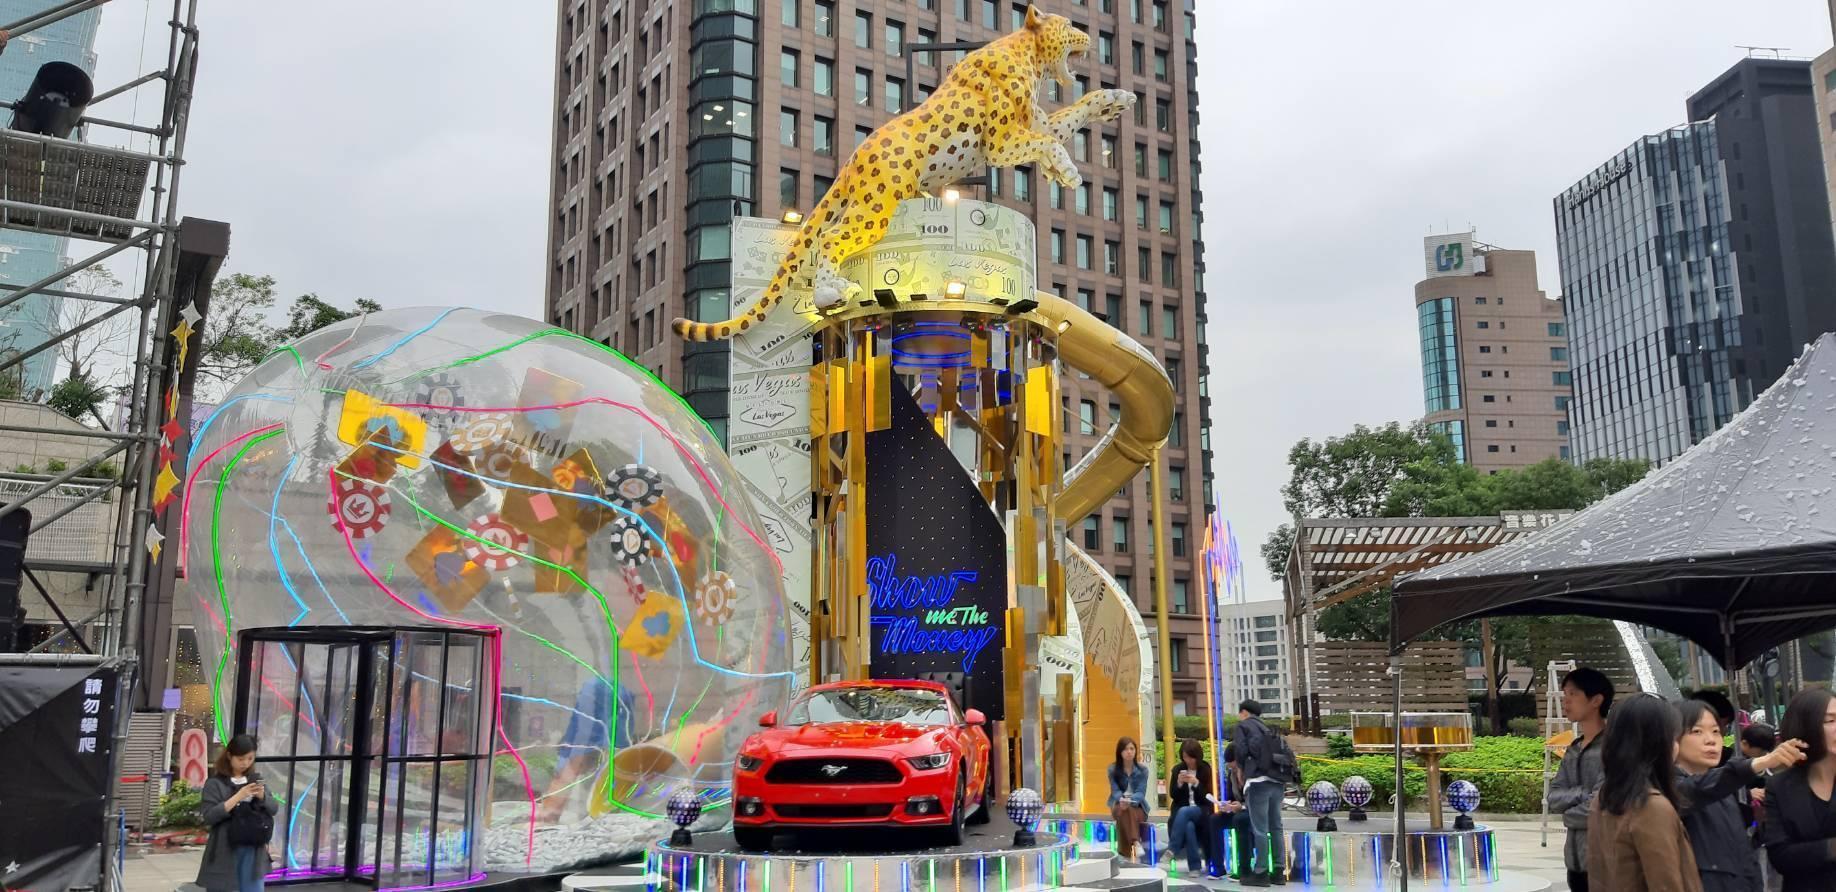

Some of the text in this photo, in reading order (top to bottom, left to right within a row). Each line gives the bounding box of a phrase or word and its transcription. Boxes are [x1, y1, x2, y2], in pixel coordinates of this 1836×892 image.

[923, 198, 943, 212] 100
[922, 225, 949, 234] 100
[1002, 277, 1016, 297] 100
[760, 334, 786, 352] 100
[753, 373, 802, 398] Vegas
[752, 410, 785, 421] Las Vegas
[738, 445, 758, 456] 100
[866, 552, 977, 609] Show
[793, 601, 810, 616] 100
[925, 604, 989, 625] me The
[869, 616, 997, 673] Money
[1046, 656, 1073, 671] 100
[78, 678, 103, 753] 請勿攀爬
